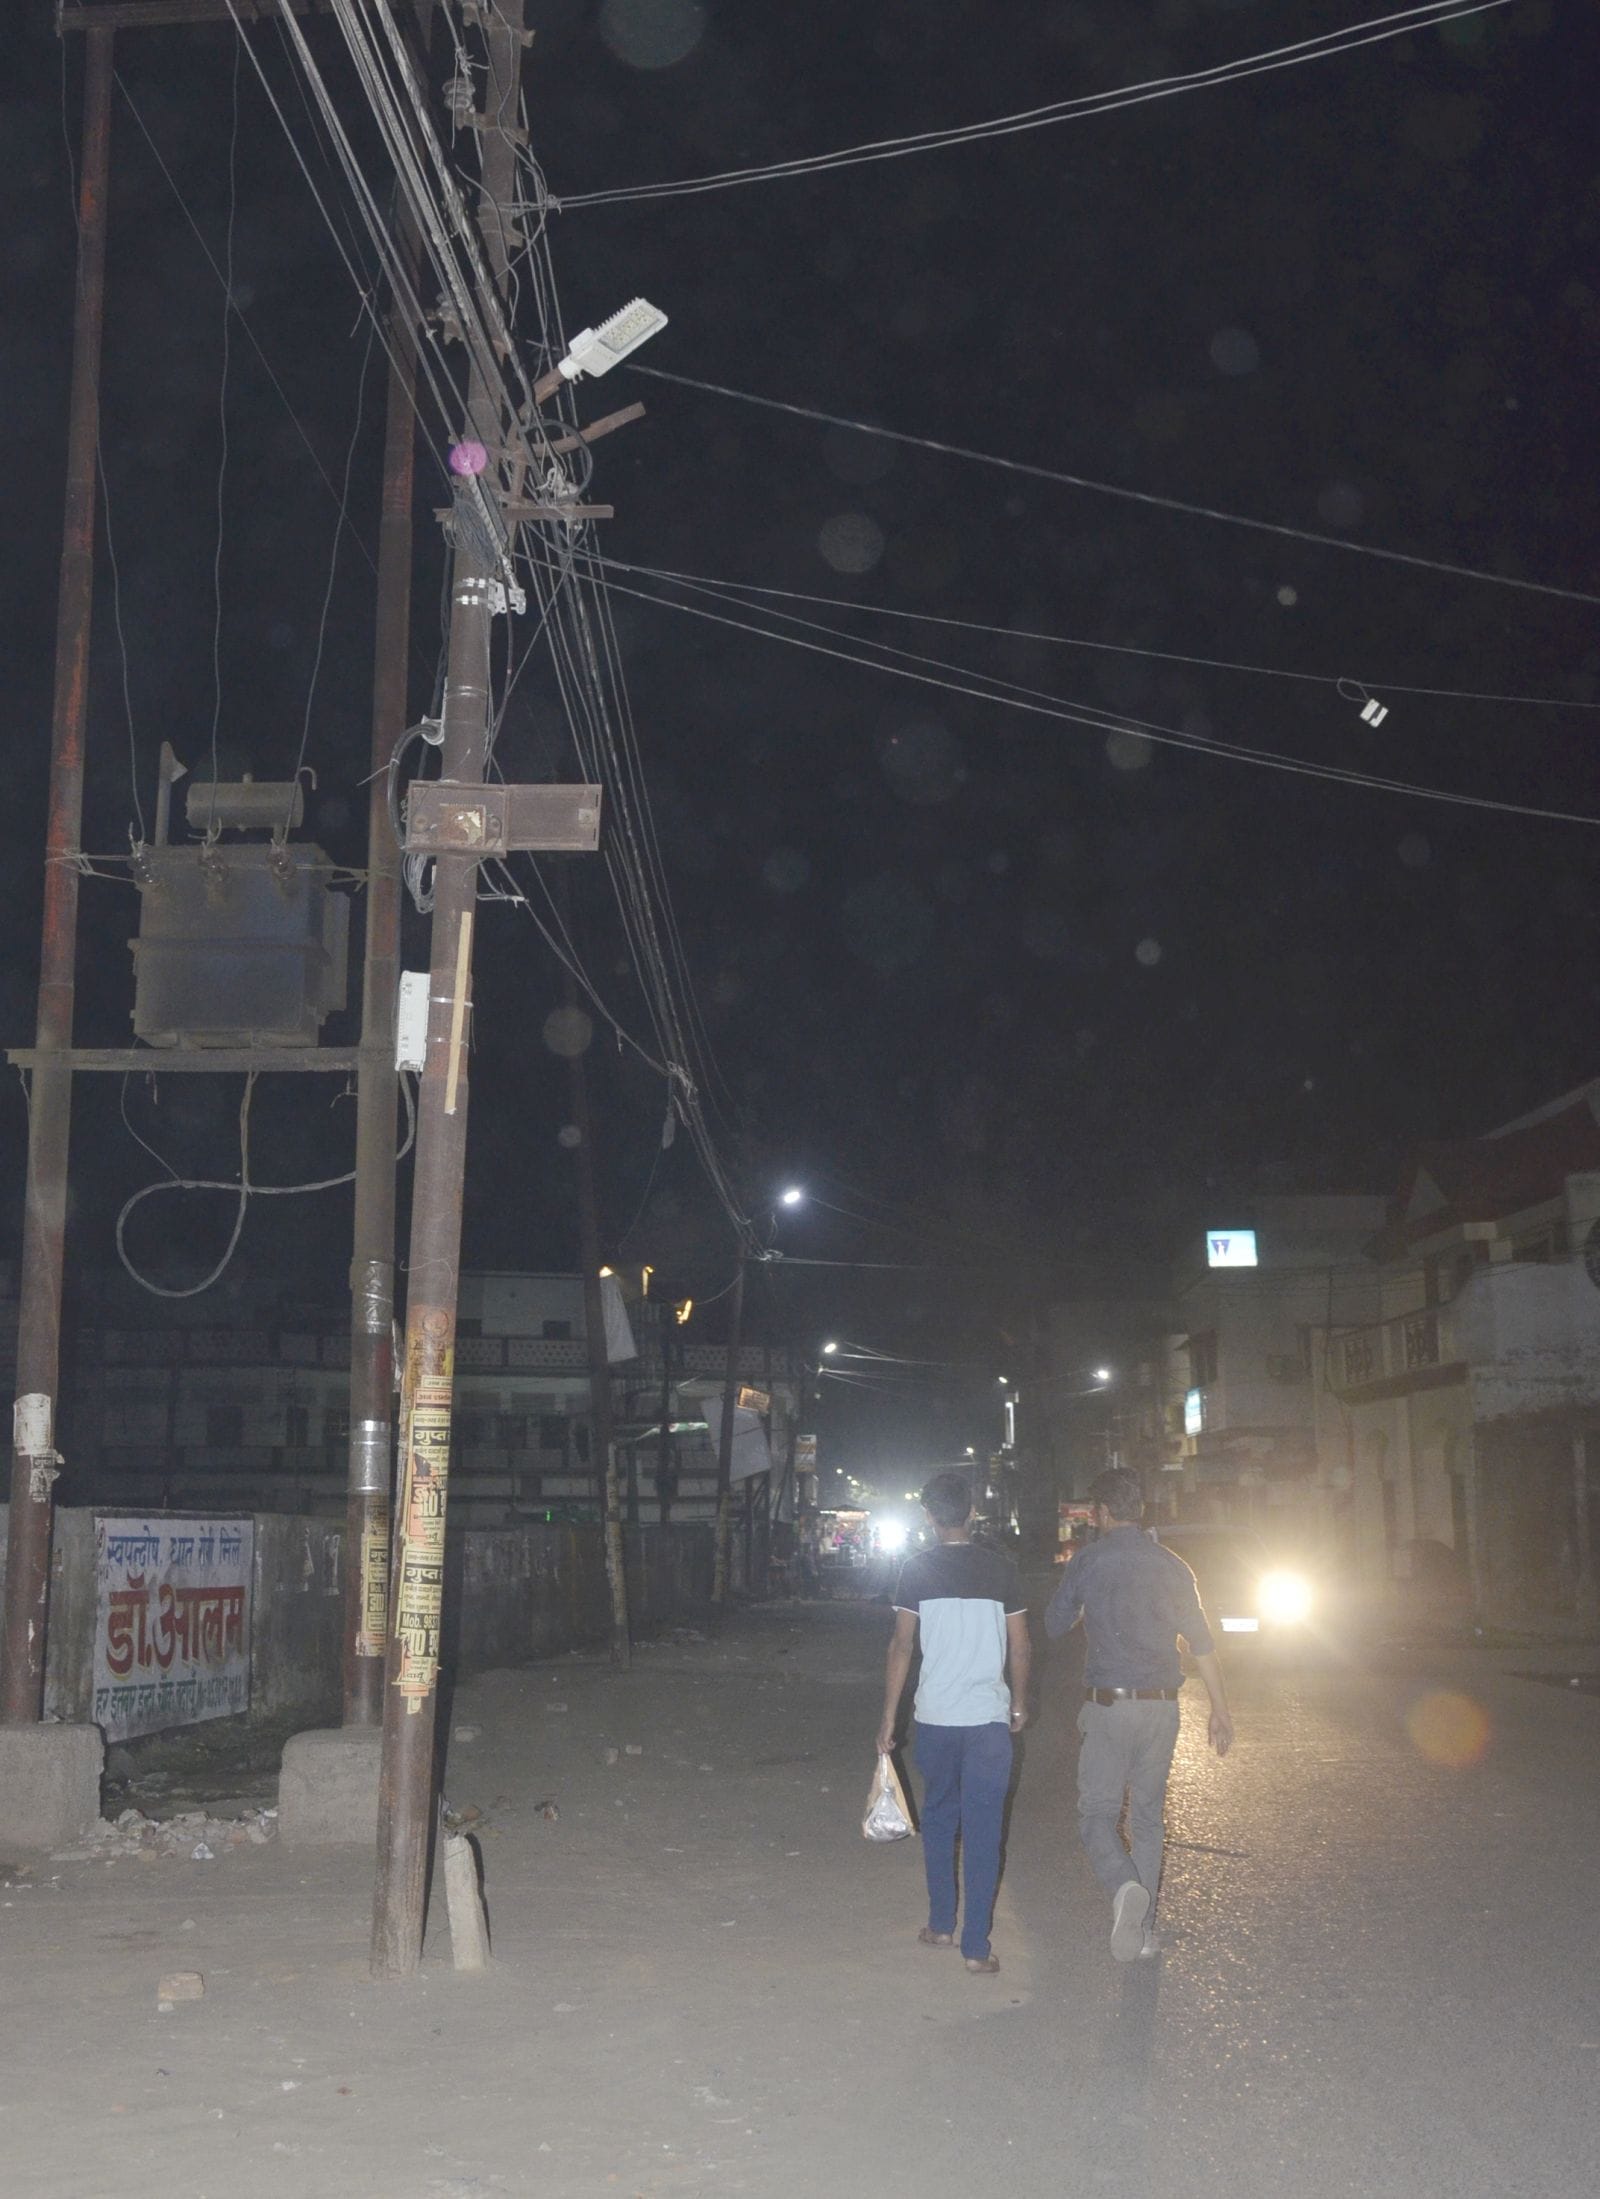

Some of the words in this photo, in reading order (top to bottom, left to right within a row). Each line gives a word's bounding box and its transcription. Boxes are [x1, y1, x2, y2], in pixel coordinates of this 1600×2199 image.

[414, 1430, 447, 1446] गुप्त
[406, 1567, 438, 1583] गुप्त
[402, 1613, 422, 1628] Mob.
